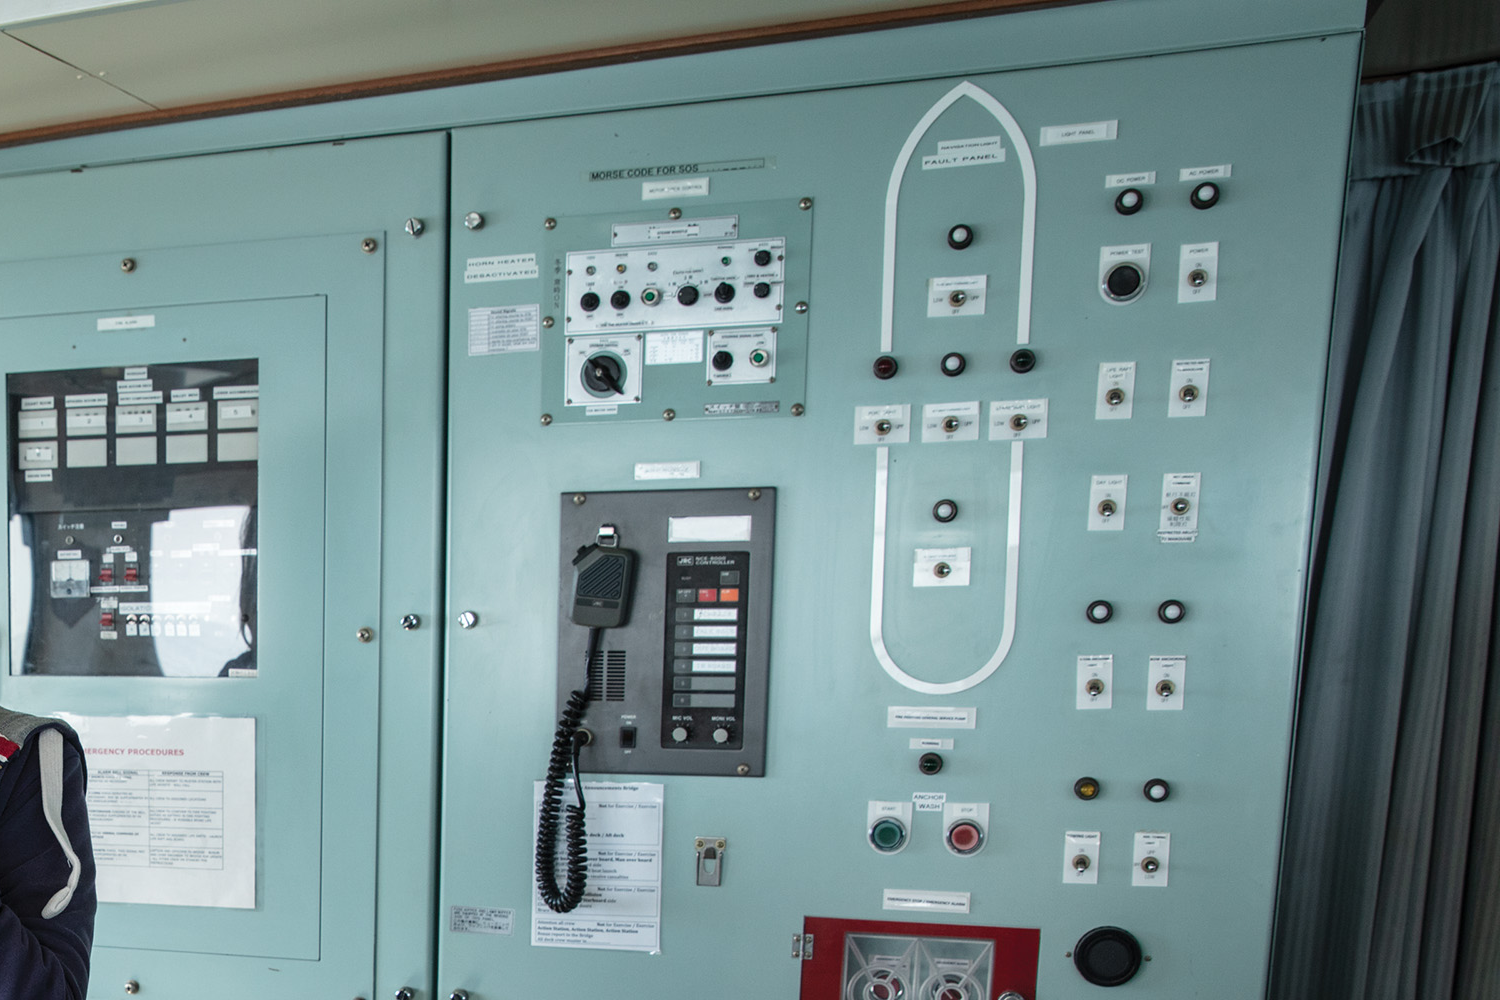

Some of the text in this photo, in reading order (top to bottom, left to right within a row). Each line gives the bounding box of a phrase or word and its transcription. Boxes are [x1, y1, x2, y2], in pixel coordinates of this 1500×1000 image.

[924, 153, 998, 166] FAULT PANEL
[591, 164, 699, 180] MORSE CODE FOR SOS
[468, 257, 535, 268] HORN HEATER
[127, 748, 185, 756] PROCEDURES
